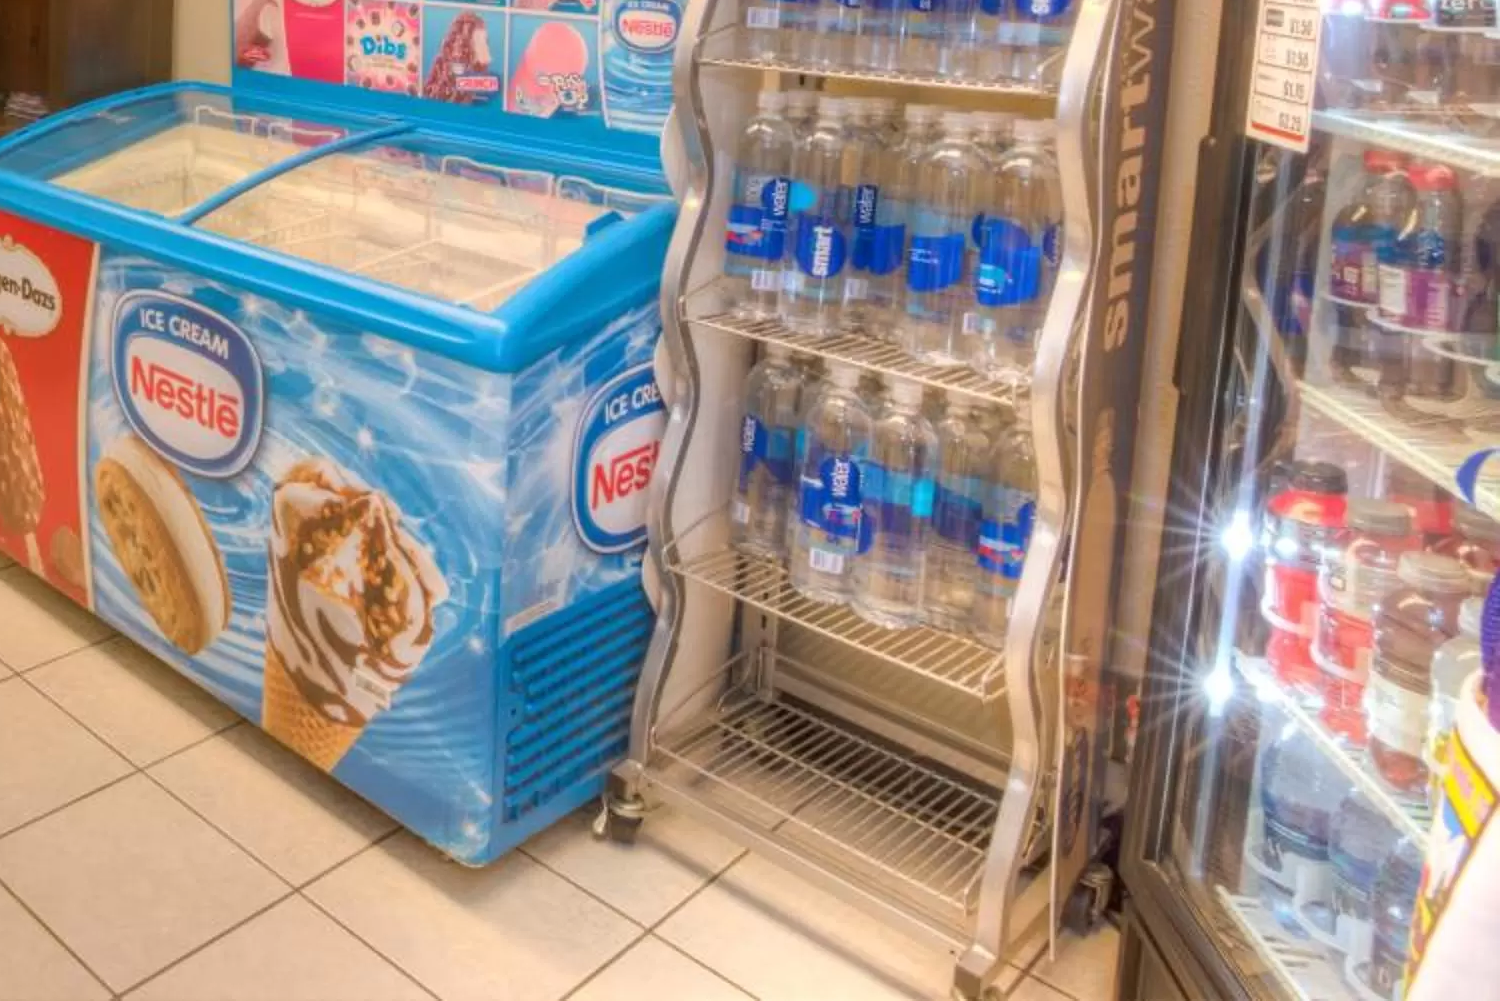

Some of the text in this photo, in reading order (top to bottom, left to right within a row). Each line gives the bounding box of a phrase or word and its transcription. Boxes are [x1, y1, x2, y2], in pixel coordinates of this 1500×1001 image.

[360, 35, 407, 60] Dibs
[772, 179, 788, 216] water
[859, 186, 875, 224] water
[812, 226, 833, 276] smart
[139, 307, 229, 360] ICE CREAM
[604, 381, 660, 425] ICE CRE
[831, 457, 850, 497] water
